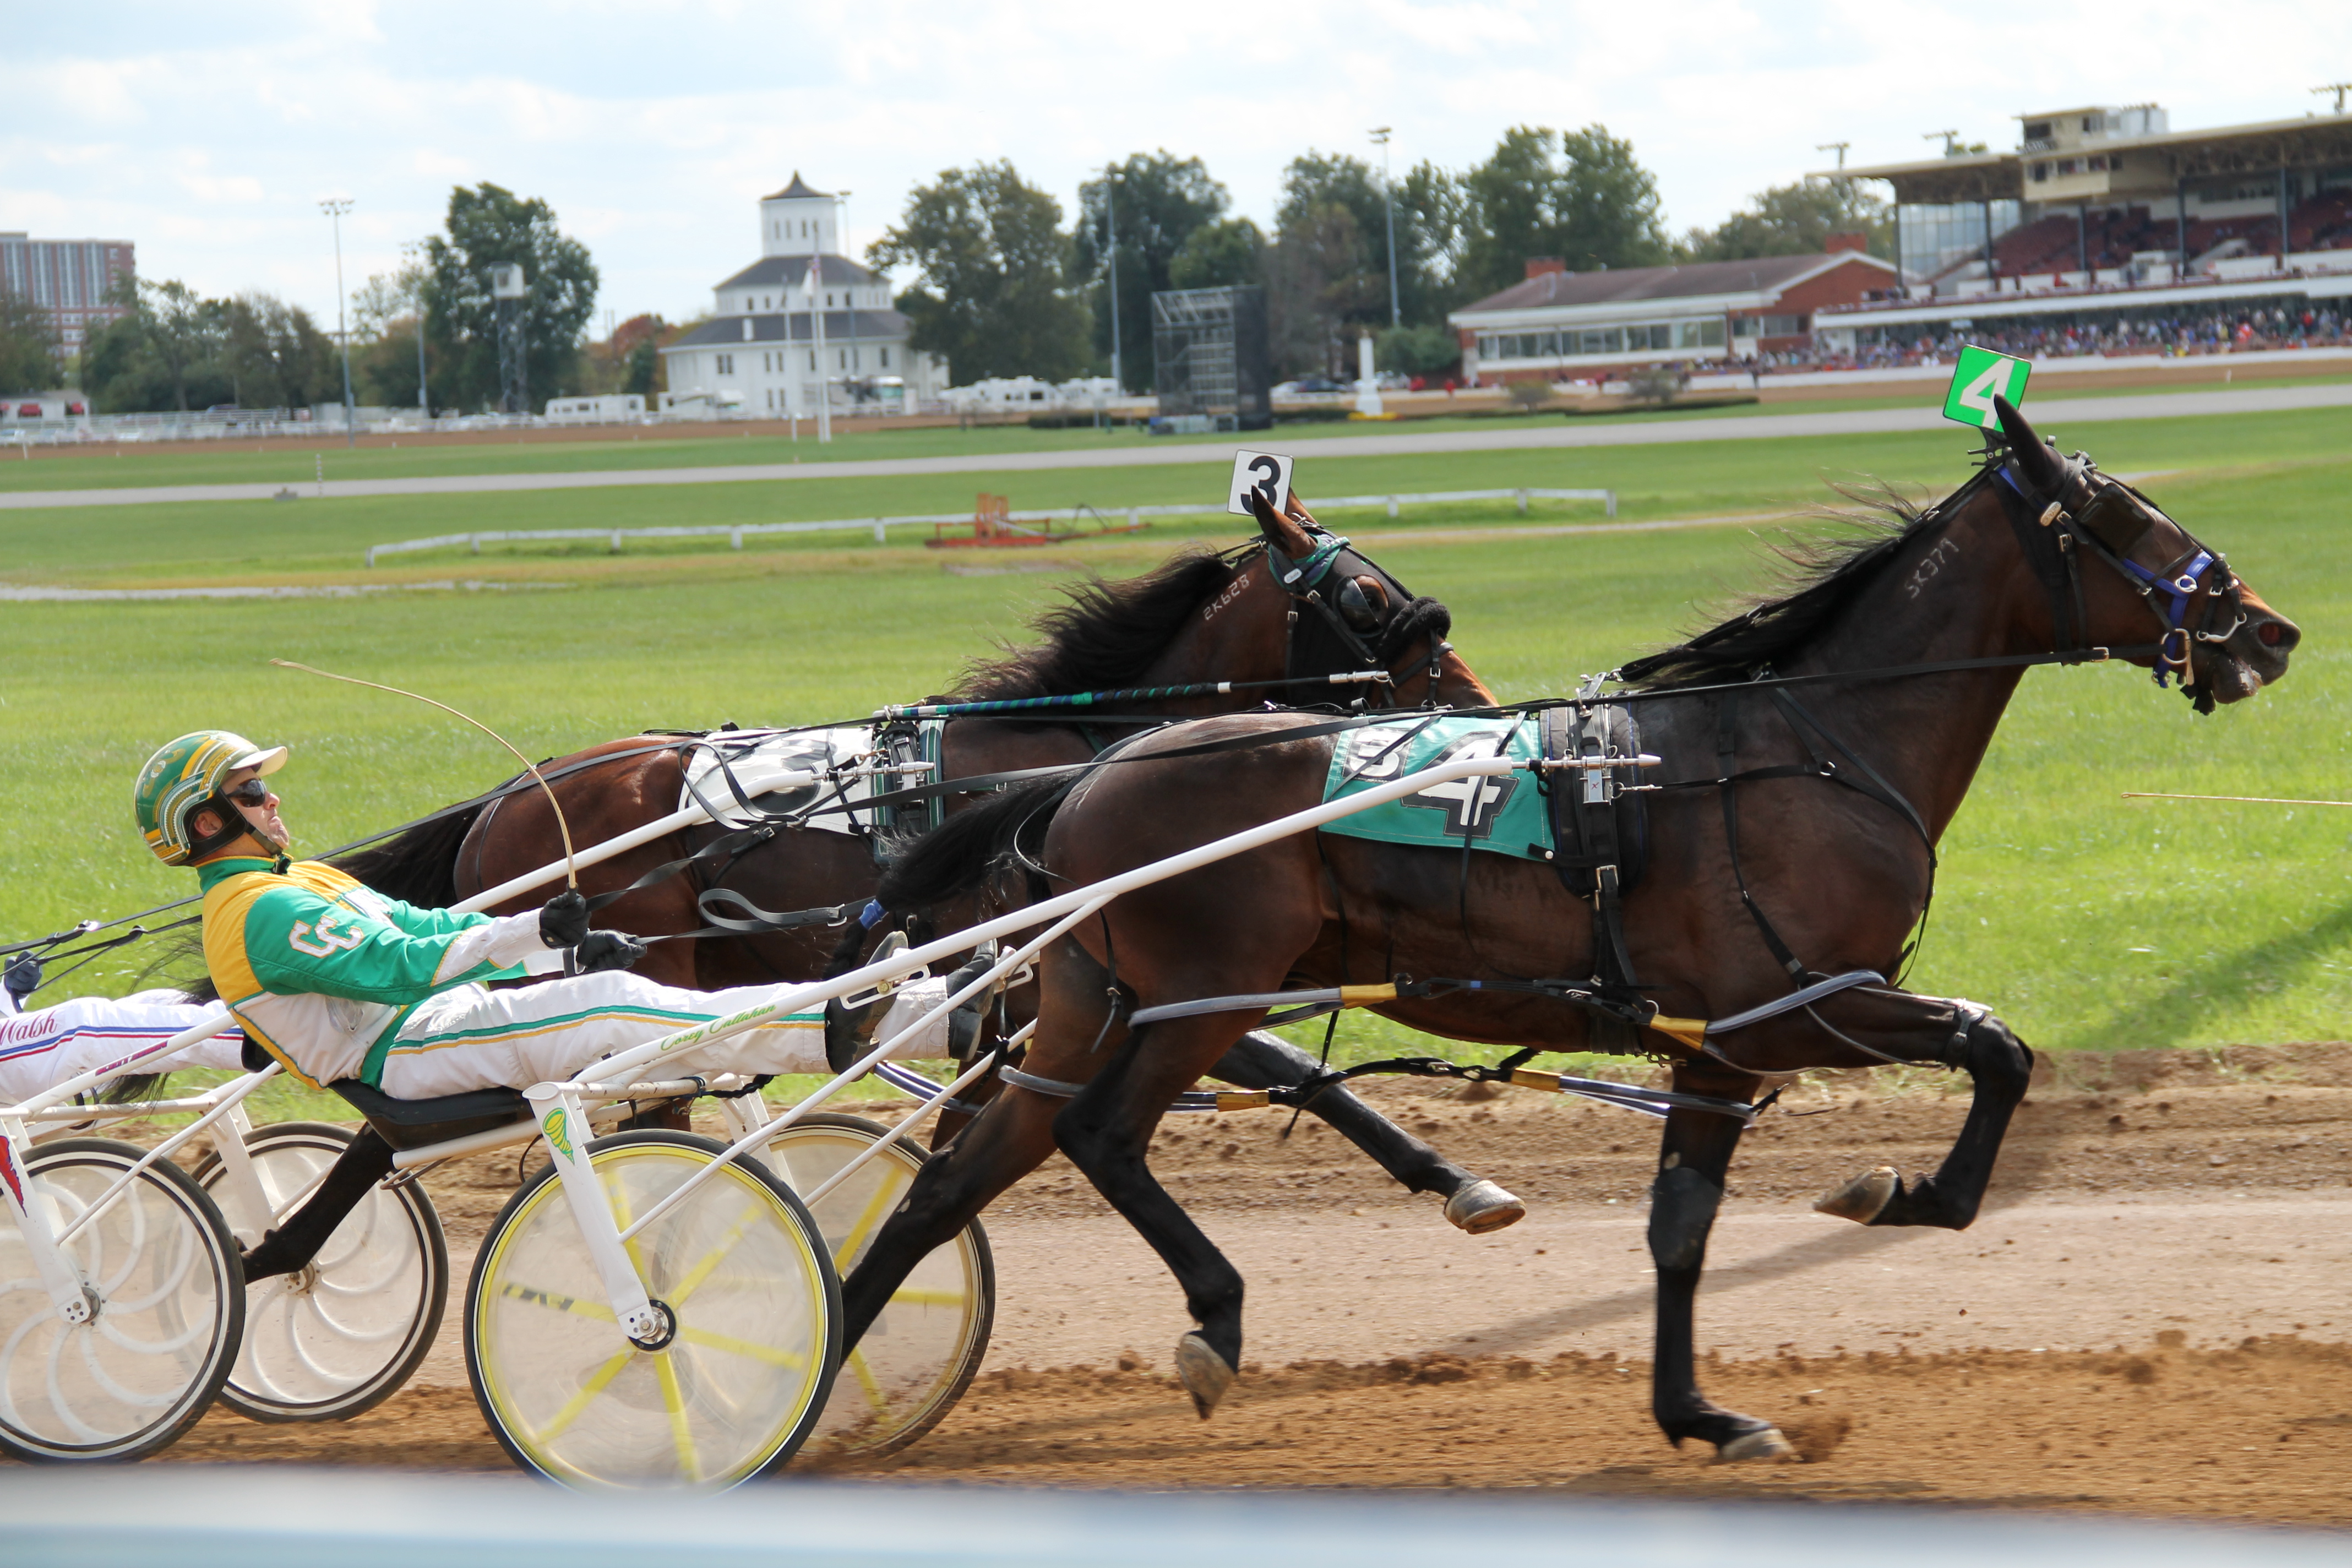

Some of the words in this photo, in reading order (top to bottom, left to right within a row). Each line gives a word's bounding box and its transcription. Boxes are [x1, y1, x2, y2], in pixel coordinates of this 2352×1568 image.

[1959, 357, 2015, 429] 4
[1240, 455, 1281, 515] 3
[1415, 737, 1503, 827] 4
[709, 1005, 776, 1034] Callahan
